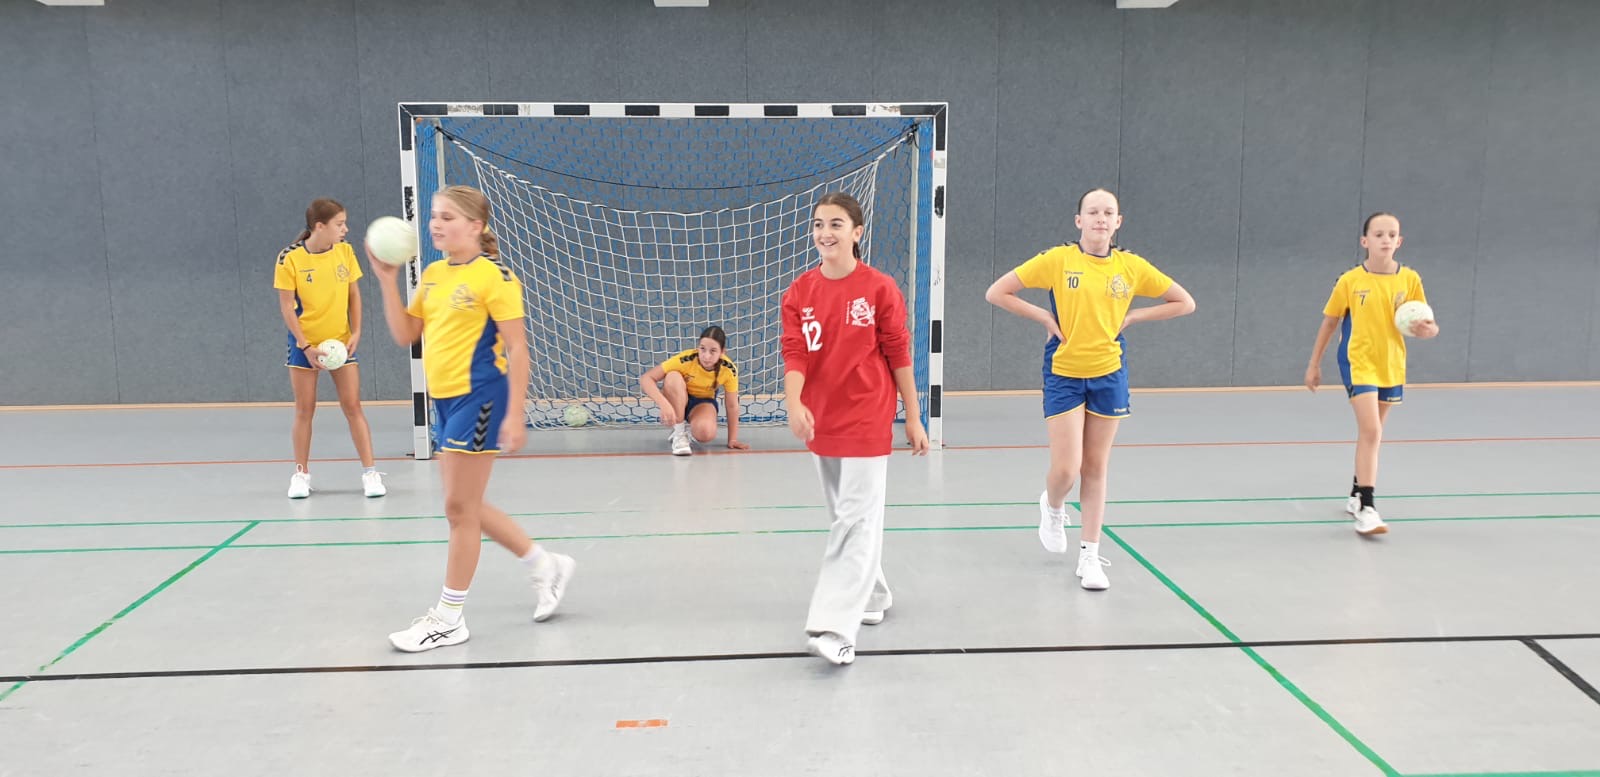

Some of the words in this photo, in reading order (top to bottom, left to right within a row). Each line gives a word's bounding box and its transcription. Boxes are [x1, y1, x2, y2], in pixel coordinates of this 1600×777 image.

[306, 273, 313, 283] 4
[1067, 276, 1079, 289] 10
[1360, 294, 1366, 306] 7
[802, 320, 823, 352] 12
